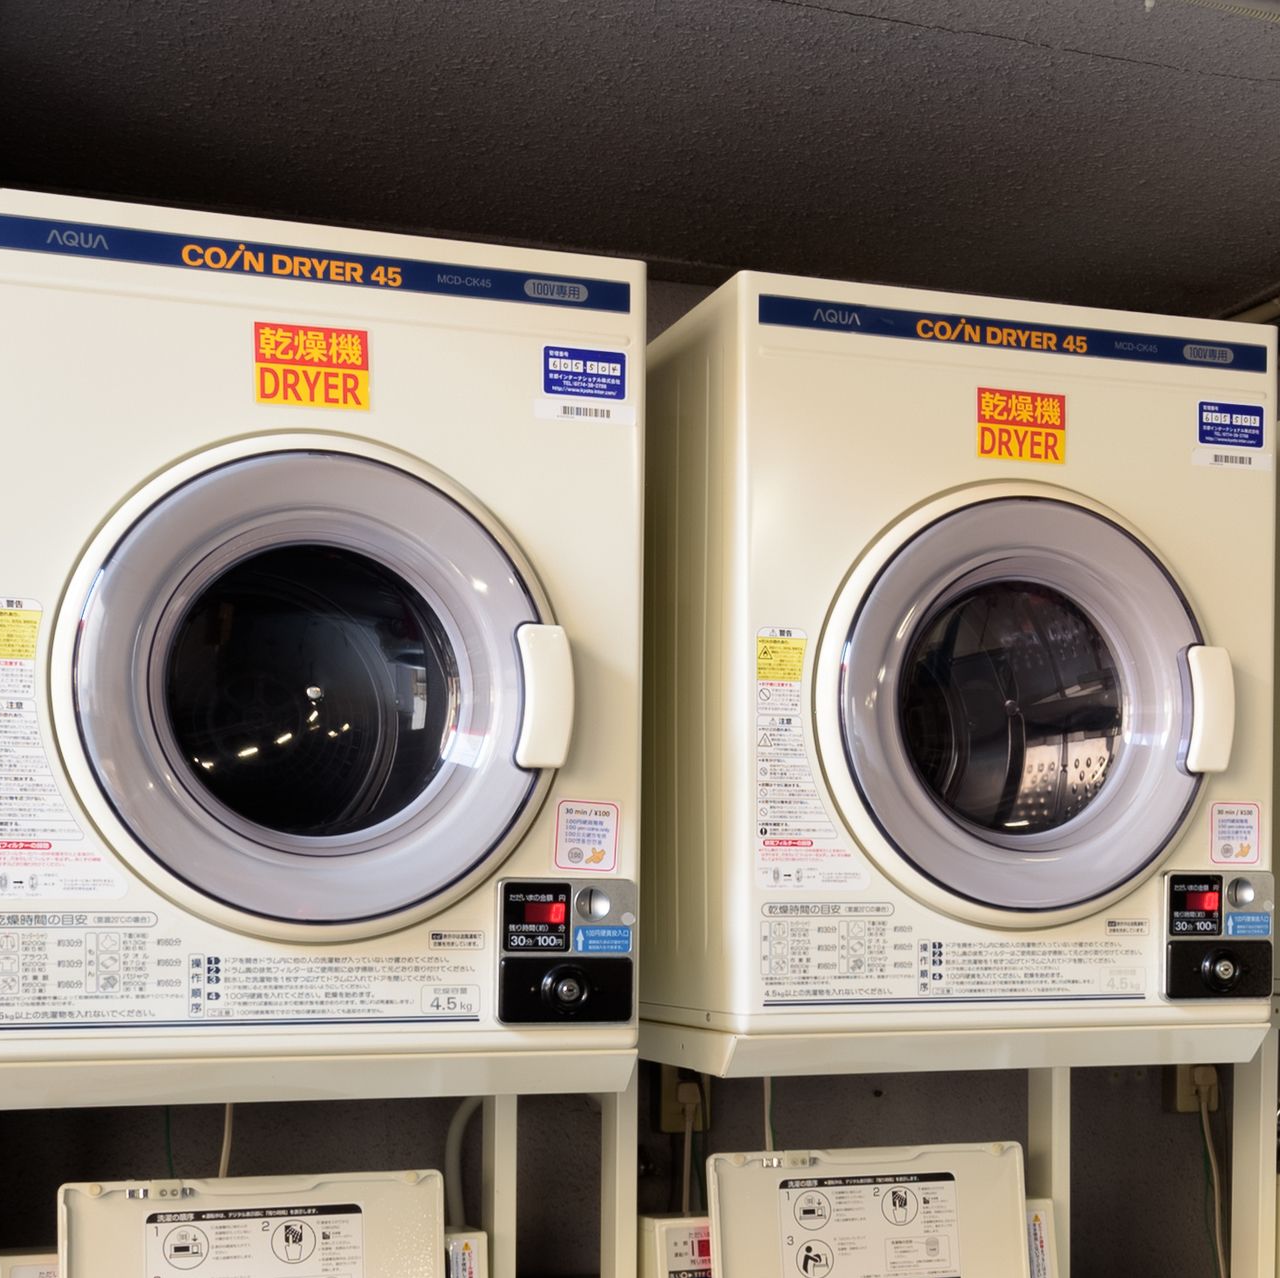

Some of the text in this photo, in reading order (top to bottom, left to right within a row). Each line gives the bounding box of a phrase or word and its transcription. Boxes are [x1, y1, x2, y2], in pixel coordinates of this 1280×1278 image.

[47, 229, 108, 250] AQUA
[181, 244, 403, 287] COIN DRYER 45
[437, 273, 491, 289] MCD-CK45
[531, 281, 580, 300] 100V専用
[812, 308, 861, 326] AQUA
[258, 326, 363, 367] 乾燥機
[916, 318, 1087, 353] COIN DRYER 45
[1114, 340, 1158, 354] MCD-CK45
[259, 368, 362, 407] DRYER
[980, 392, 1061, 426] 乾燥機
[980, 427, 1059, 460] DRYER
[429, 997, 457, 1011] 4.5
